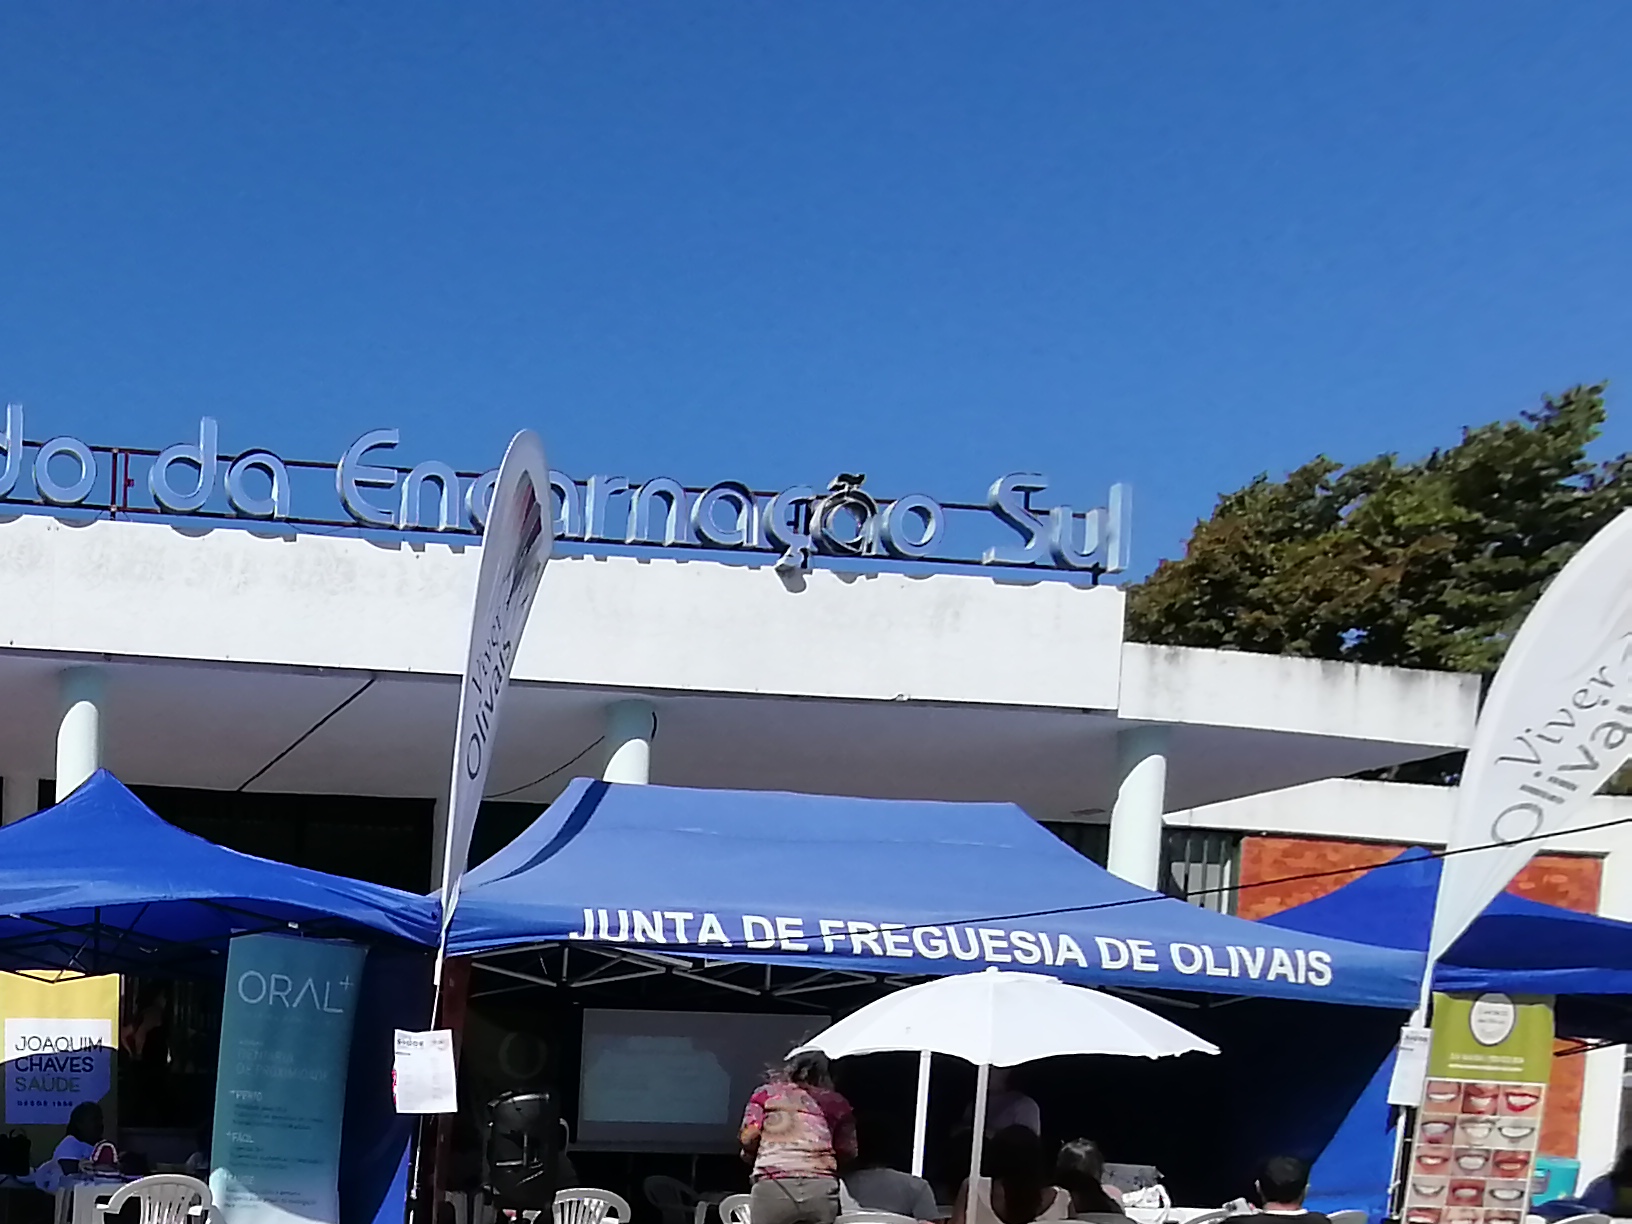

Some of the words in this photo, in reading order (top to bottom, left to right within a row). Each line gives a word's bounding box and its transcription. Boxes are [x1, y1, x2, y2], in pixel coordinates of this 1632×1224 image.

[148, 415, 290, 520] da
[982, 472, 1133, 574] Sul
[467, 639, 511, 780] Olivais
[1494, 665, 1616, 769] Viver
[568, 907, 733, 947] JUNTA
[741, 914, 810, 952] DE
[818, 918, 1089, 969] FREGUESIA
[1094, 935, 1160, 972] DE
[1169, 942, 1333, 987] OLIVAIS
[14, 1035, 103, 1053] JOAQUIM
[14, 1056, 94, 1073] CHAVES
[14, 1073, 81, 1093] SAÚDE
